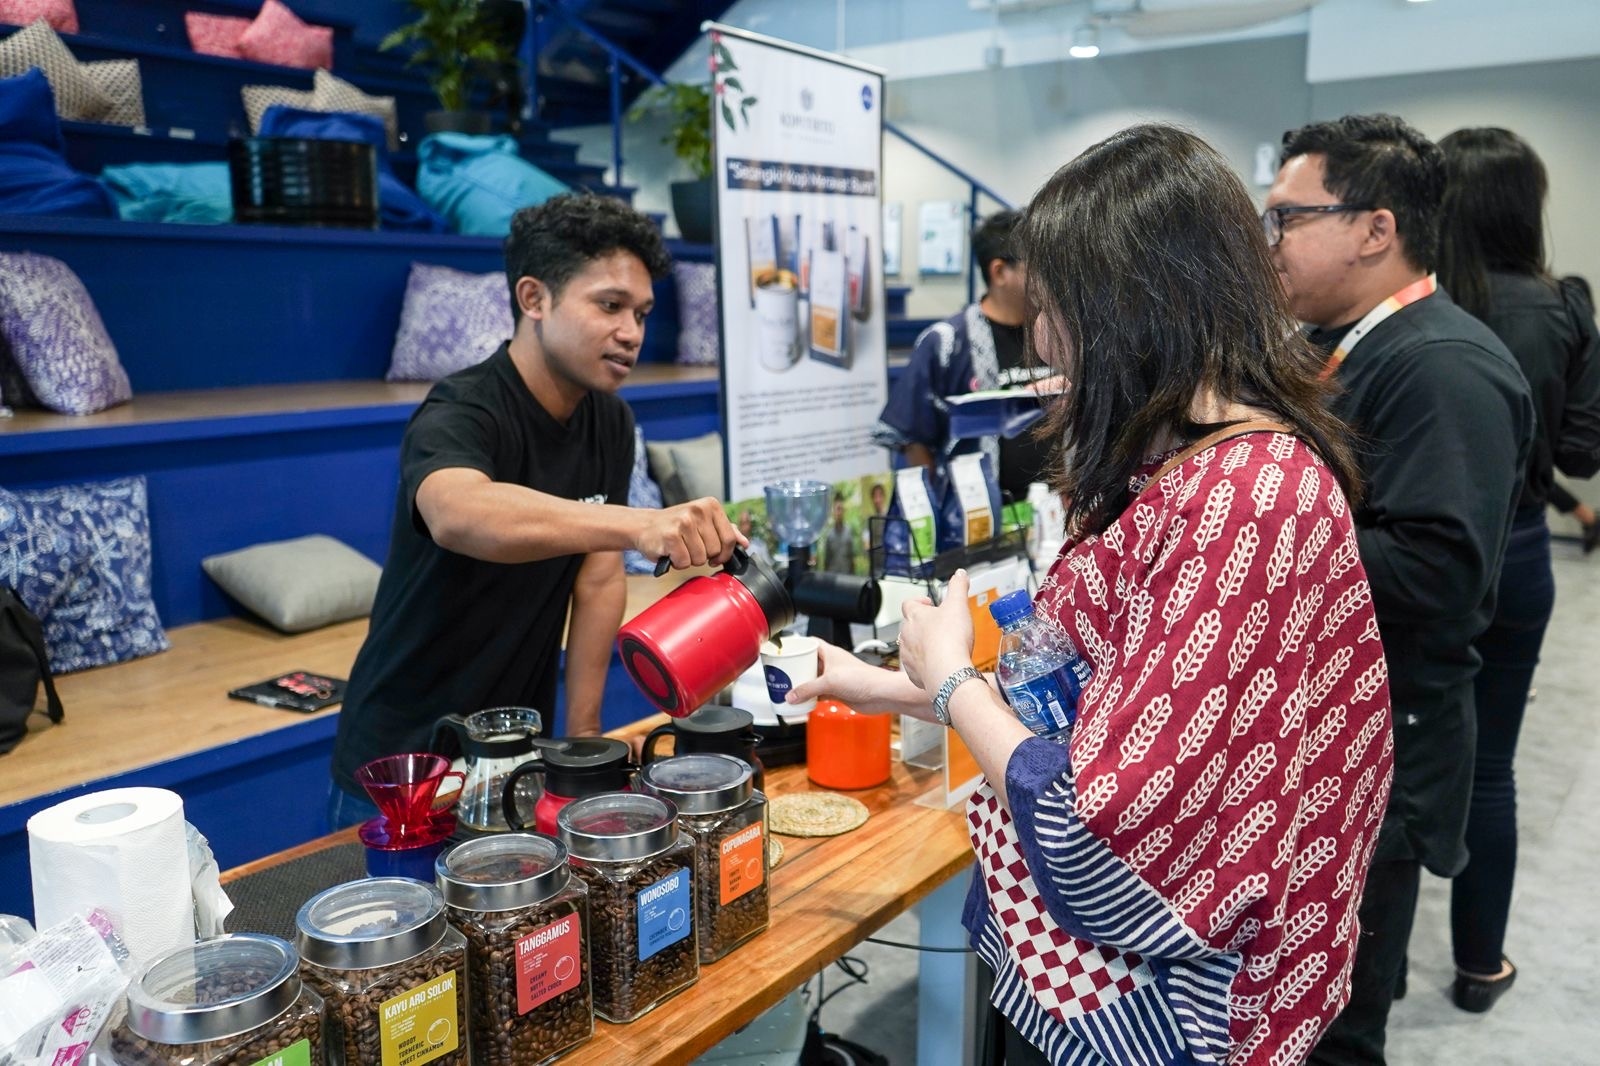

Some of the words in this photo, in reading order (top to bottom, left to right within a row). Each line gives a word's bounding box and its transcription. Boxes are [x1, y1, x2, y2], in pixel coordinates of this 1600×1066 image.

[640, 876, 679, 907] WONOSOBO
[518, 920, 570, 956] TANGGAMUS
[385, 998, 408, 1020] KAYU
[409, 991, 426, 1009] ARO
[427, 977, 453, 999] SOLOK
[398, 1036, 416, 1050] WOODY
[399, 1041, 425, 1059] TURMERIC
[417, 1041, 444, 1058] CINNAMON
